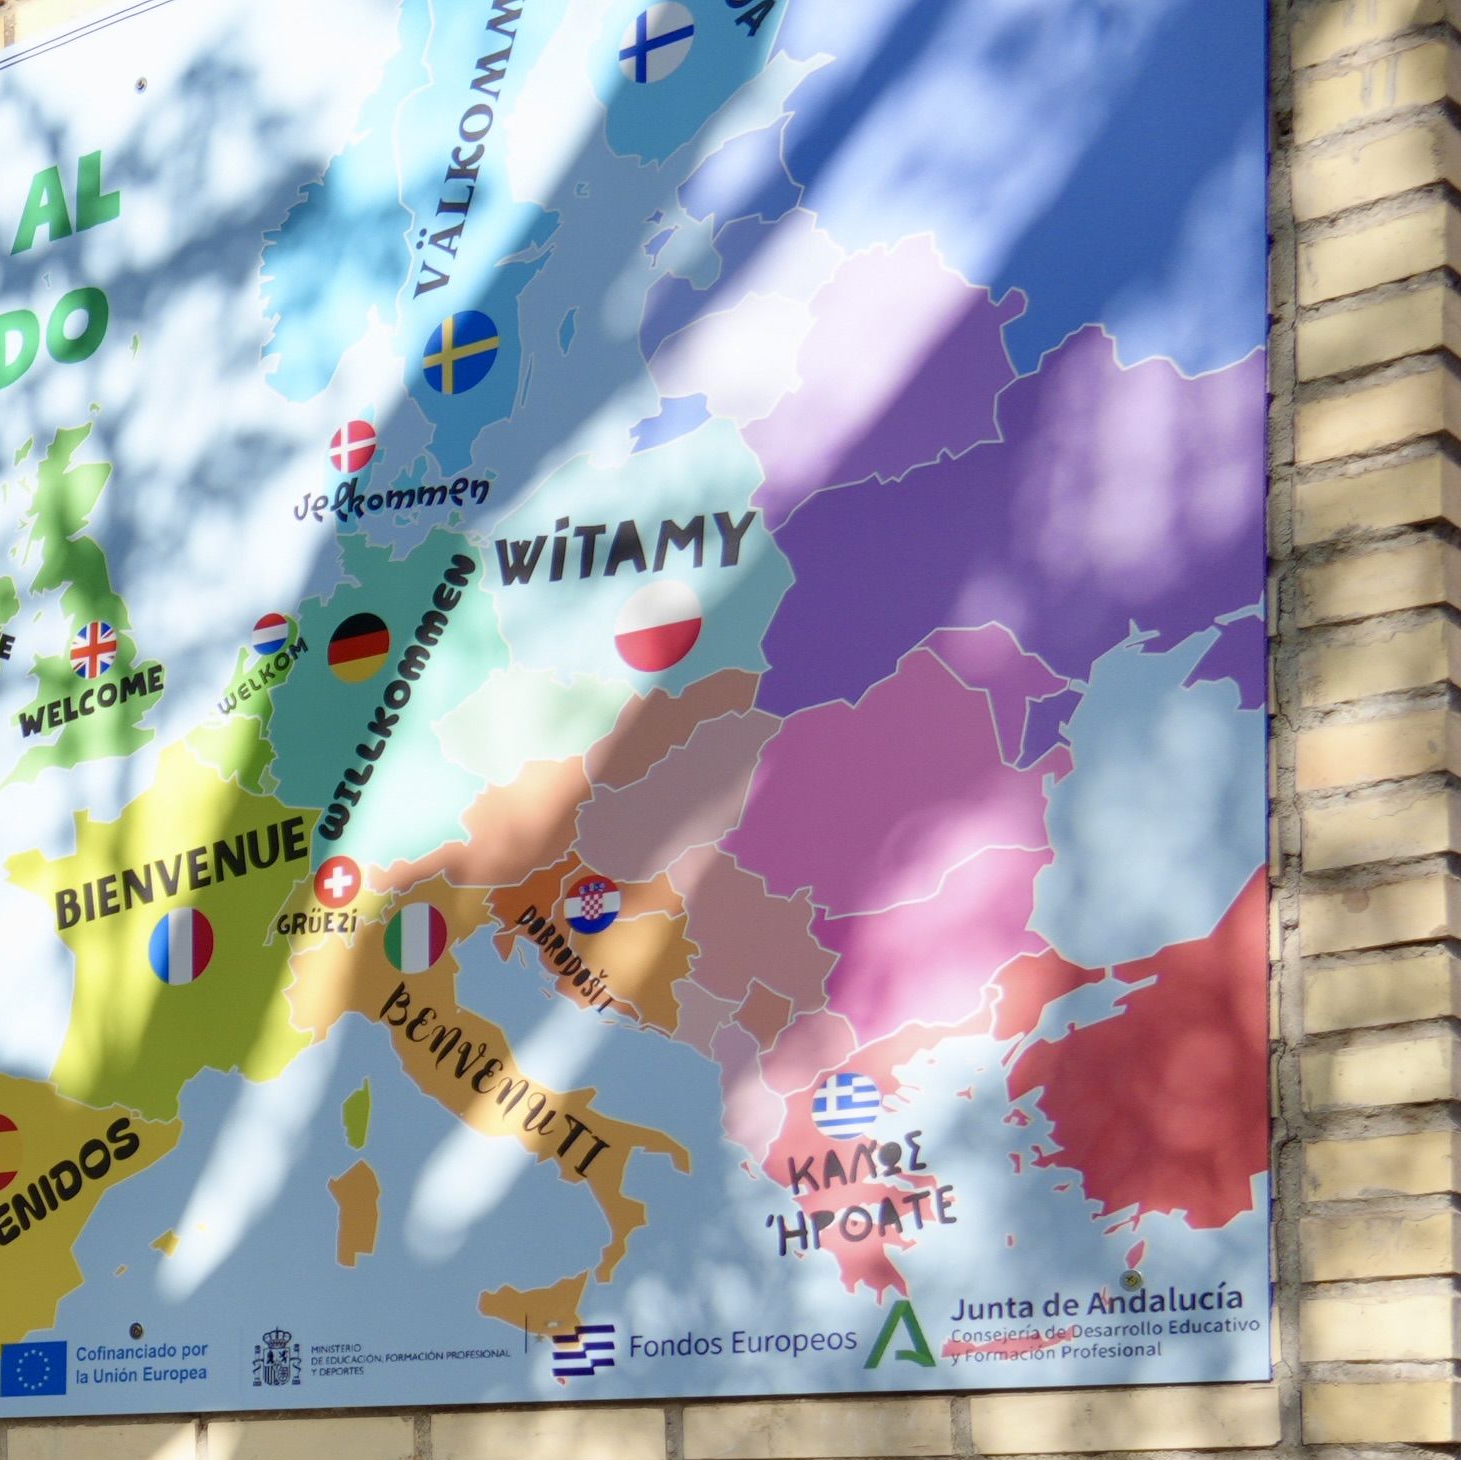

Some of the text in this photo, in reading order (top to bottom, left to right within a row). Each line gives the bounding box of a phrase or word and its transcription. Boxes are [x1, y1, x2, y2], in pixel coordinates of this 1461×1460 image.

[10, 150, 121, 255] AL
[218, 637, 309, 715] WELKOM
[19, 664, 165, 739] WELCOME
[317, 553, 476, 841] WILLKOMMEN
[55, 815, 308, 931] BIENVENUE
[378, 981, 611, 1178] BENVENUTI
[951, 1282, 1244, 1321] Junta de Andalucía
[630, 1331, 858, 1357] Fondos Europeos
[951, 1316, 1261, 1345] Consejería de Desarrollo Educativo
[76, 1343, 208, 1361] Cofinanciado por
[311, 1344, 362, 1354] MINISTERIO
[311, 1356, 324, 1366] DE
[386, 1350, 444, 1363] FORMACIÓN
[446, 1349, 511, 1359] PROFESIONAL
[951, 1341, 1163, 1367] y Formación Profesional
[76, 1366, 207, 1384] la Unión Europea
[311, 1366, 364, 1376] Y DEPORTES
